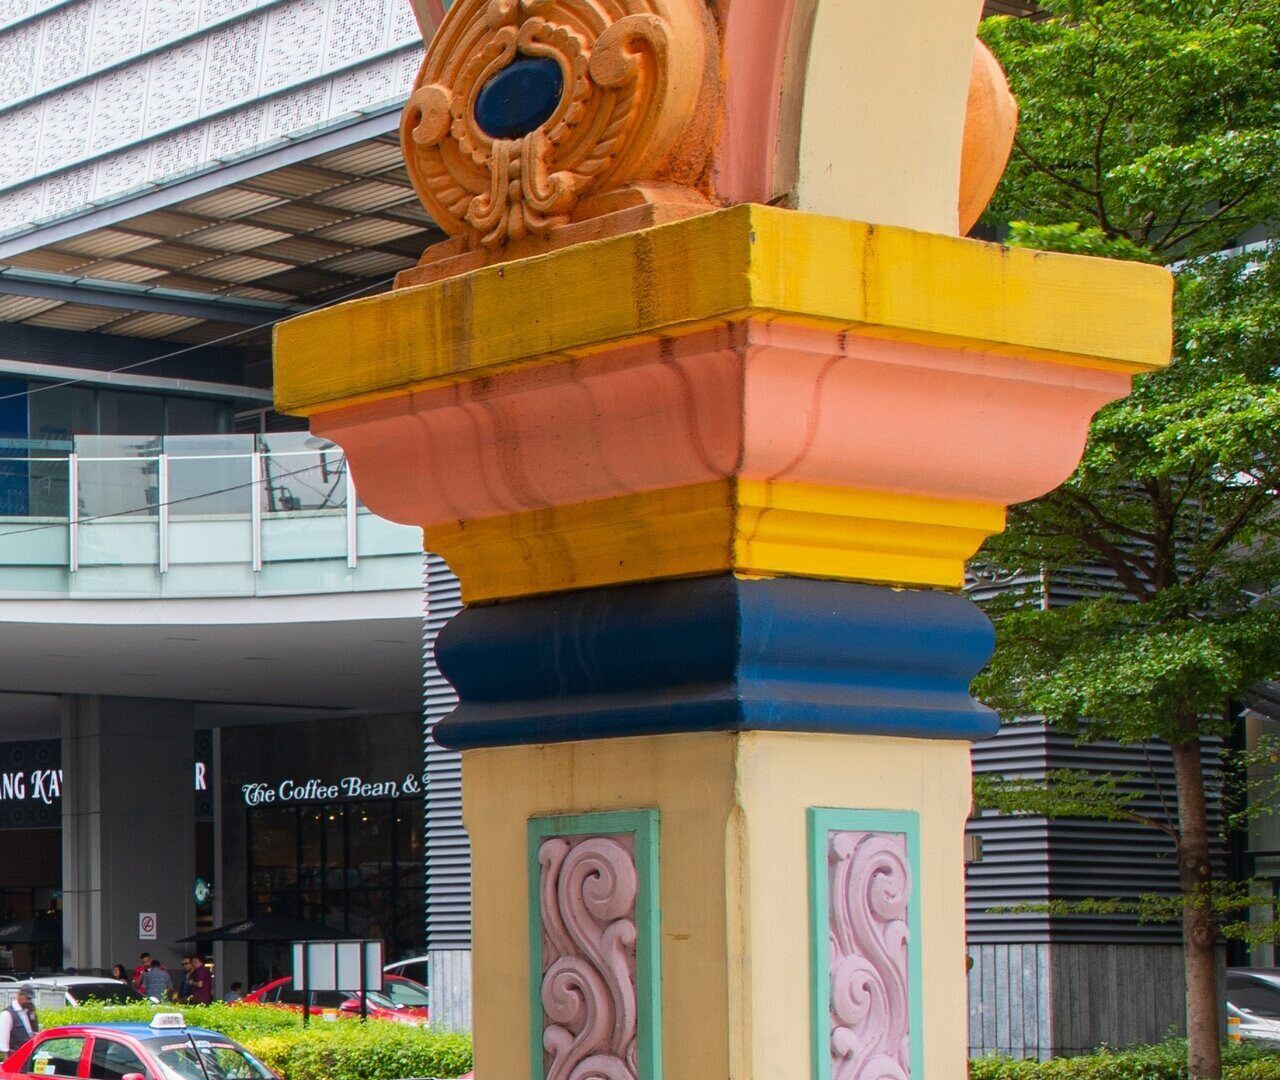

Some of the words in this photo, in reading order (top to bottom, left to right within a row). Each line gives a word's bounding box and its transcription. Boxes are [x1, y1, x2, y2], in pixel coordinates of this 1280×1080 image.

[241, 782, 275, 806] The
[279, 779, 338, 801] Coffee
[341, 775, 400, 798] Bean
[402, 773, 421, 794] &
